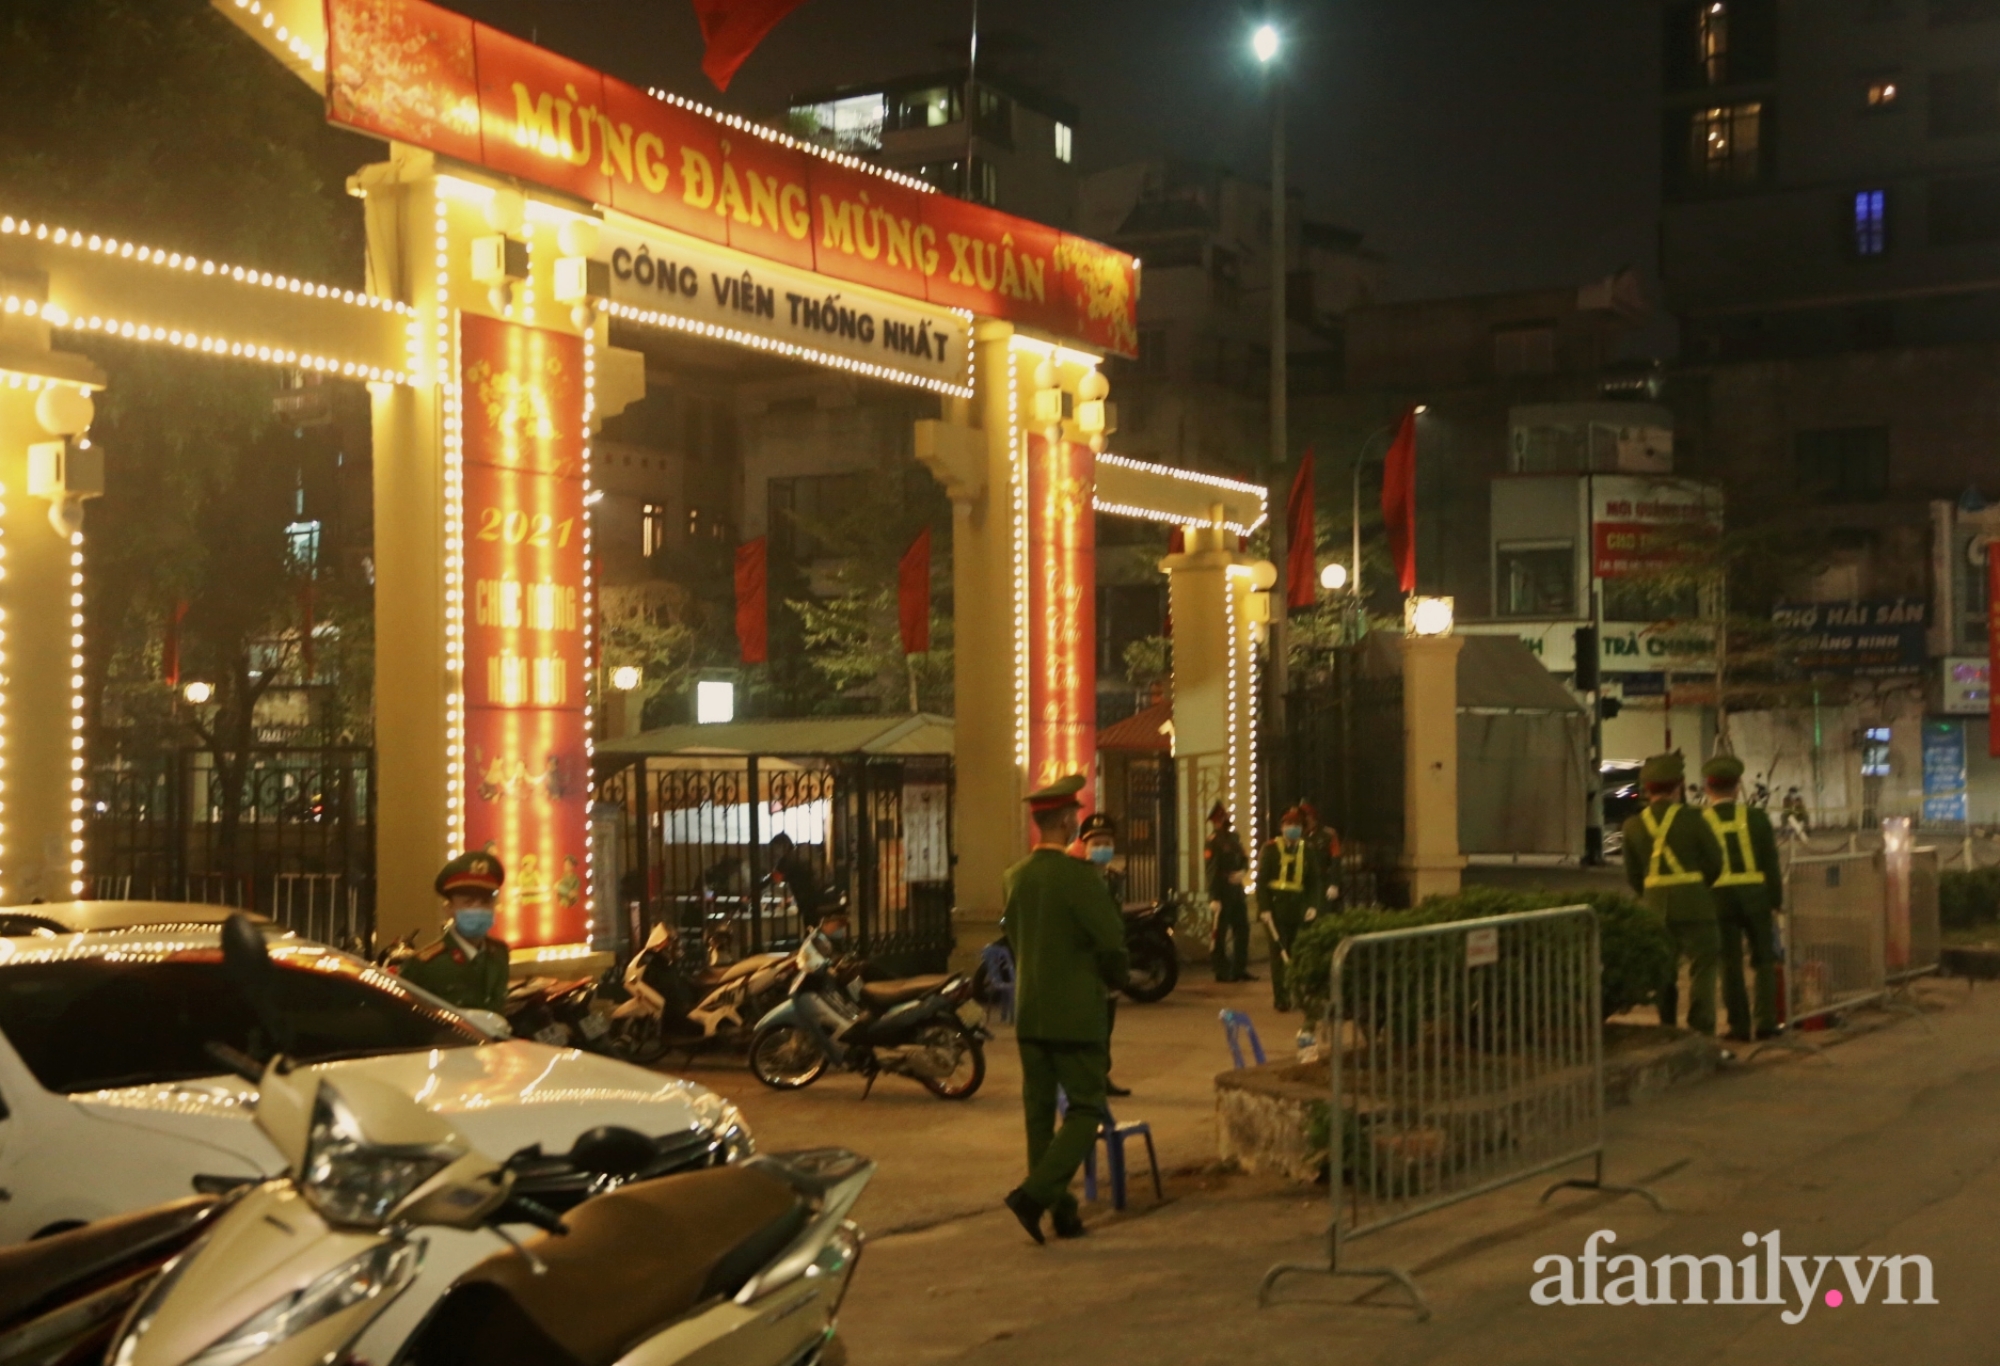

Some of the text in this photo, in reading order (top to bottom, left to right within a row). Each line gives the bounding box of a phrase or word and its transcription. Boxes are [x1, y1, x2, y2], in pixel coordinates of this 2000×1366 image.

[511, 80, 1046, 303] MỪNG ĐẢNG MỪNG XUÂN
[611, 243, 949, 362] CÔNG VIÊN THỐNG NHẤT
[476, 506, 575, 549] 2021
[475, 571, 523, 629] CHÚC
[1874, 598, 1926, 625] SẢN
[1856, 634, 1901, 649] NINH
